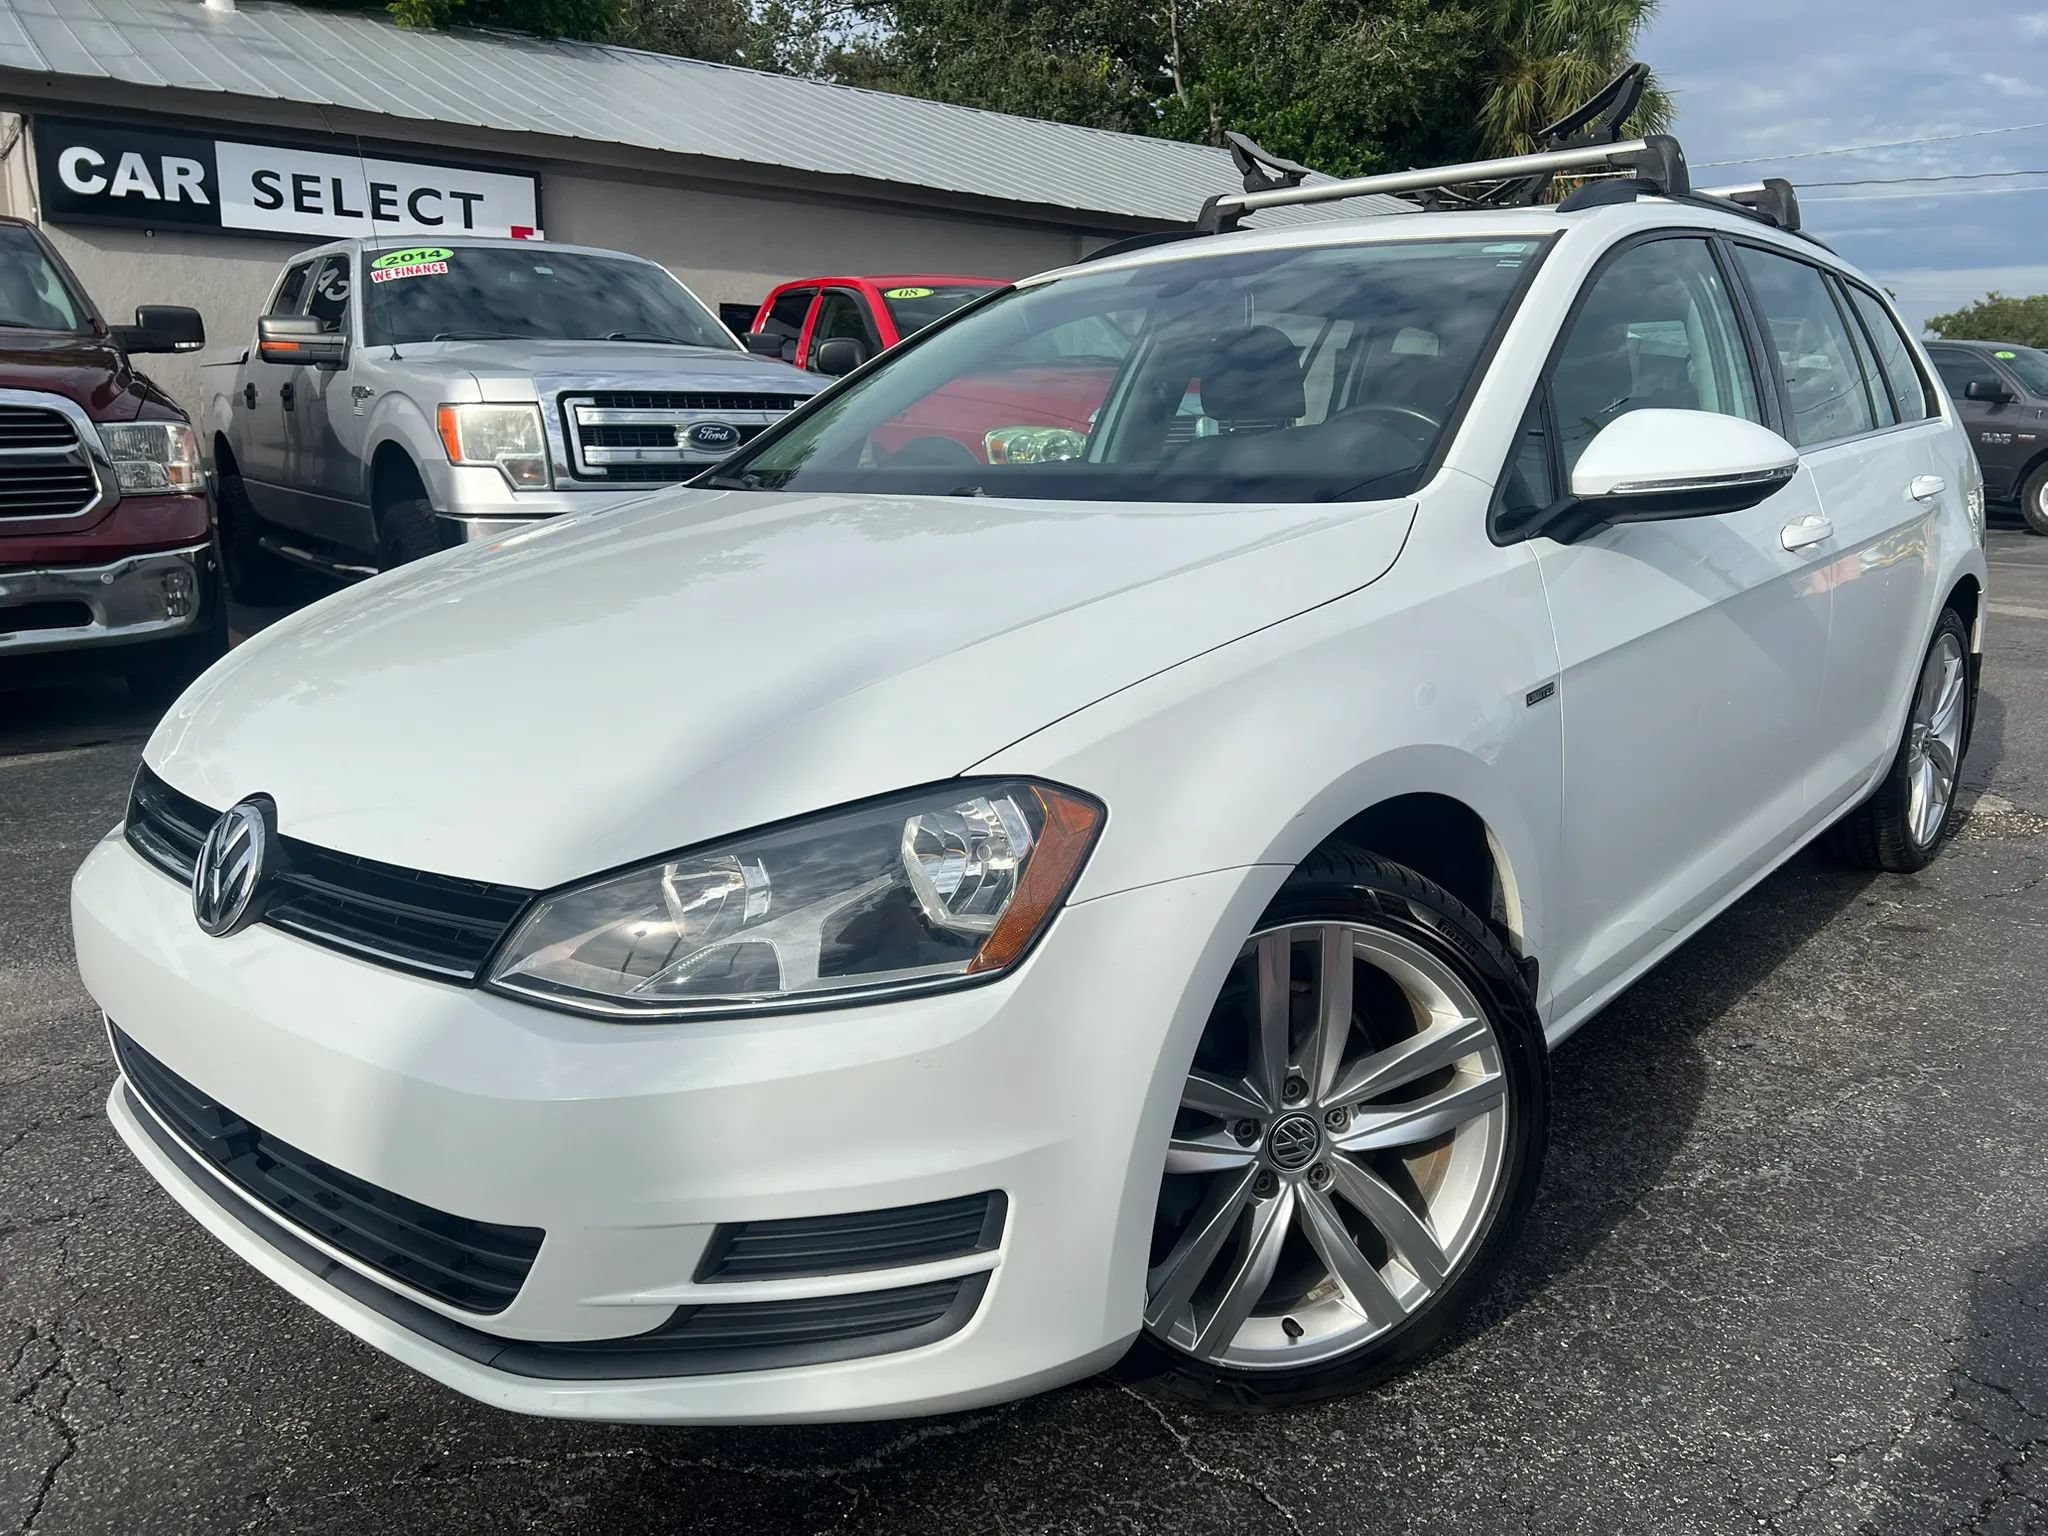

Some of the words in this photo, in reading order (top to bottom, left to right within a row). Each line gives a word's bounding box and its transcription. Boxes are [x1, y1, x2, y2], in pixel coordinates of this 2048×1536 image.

[58, 146, 210, 205] CAR
[251, 170, 484, 230] SELECT
[385, 250, 443, 266] 2014
[373, 269, 392, 281] WE
[394, 263, 447, 278] FINANCE
[699, 427, 729, 440] Ford
